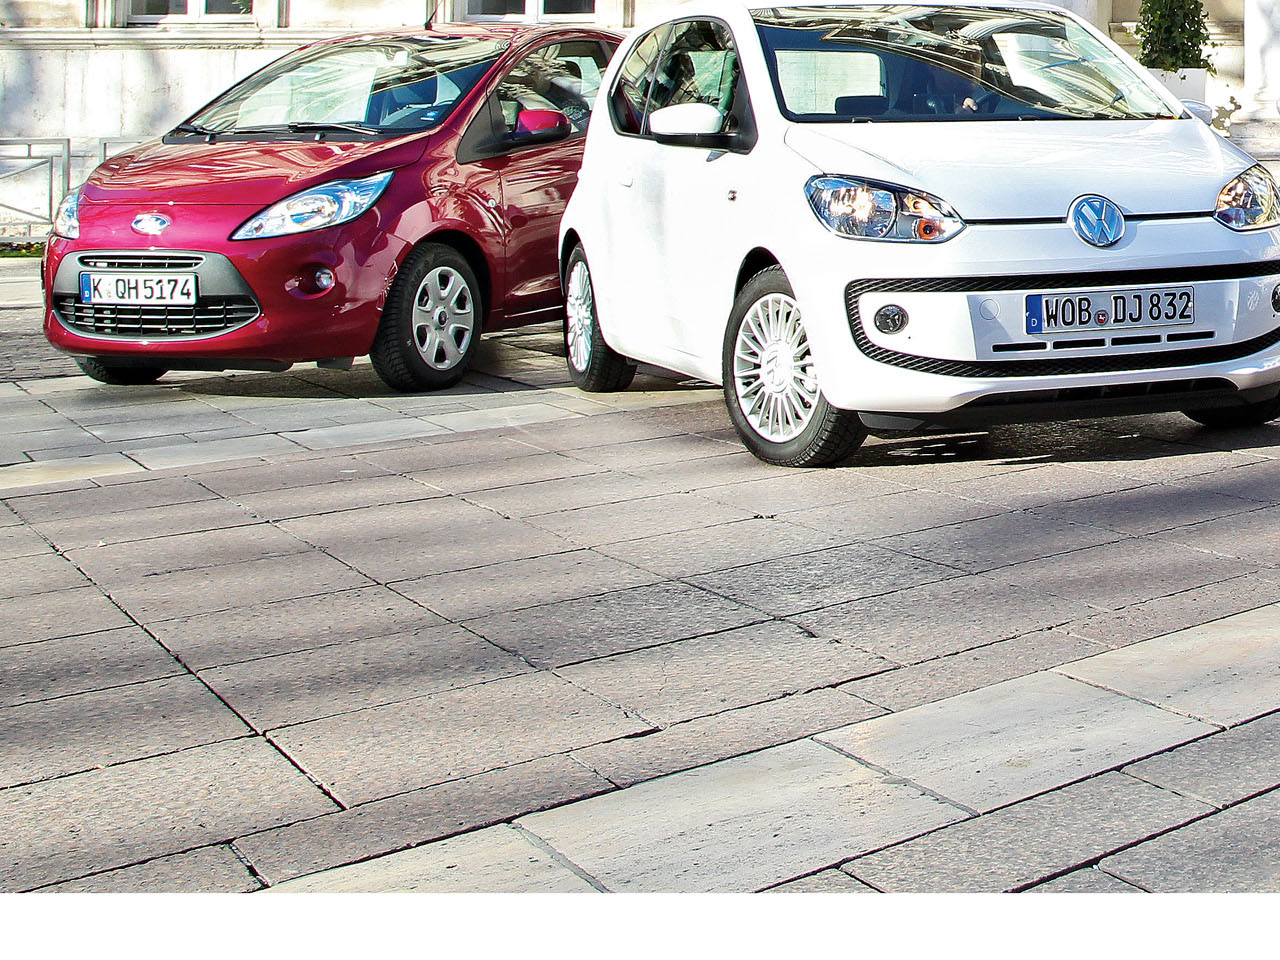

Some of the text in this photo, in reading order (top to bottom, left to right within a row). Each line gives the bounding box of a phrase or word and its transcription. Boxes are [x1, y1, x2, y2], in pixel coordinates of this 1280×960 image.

[92, 278, 103, 299] K
[115, 278, 139, 299] QH
[143, 279, 192, 300] 5174
[1031, 292, 1192, 328] D WOB DJ 832
